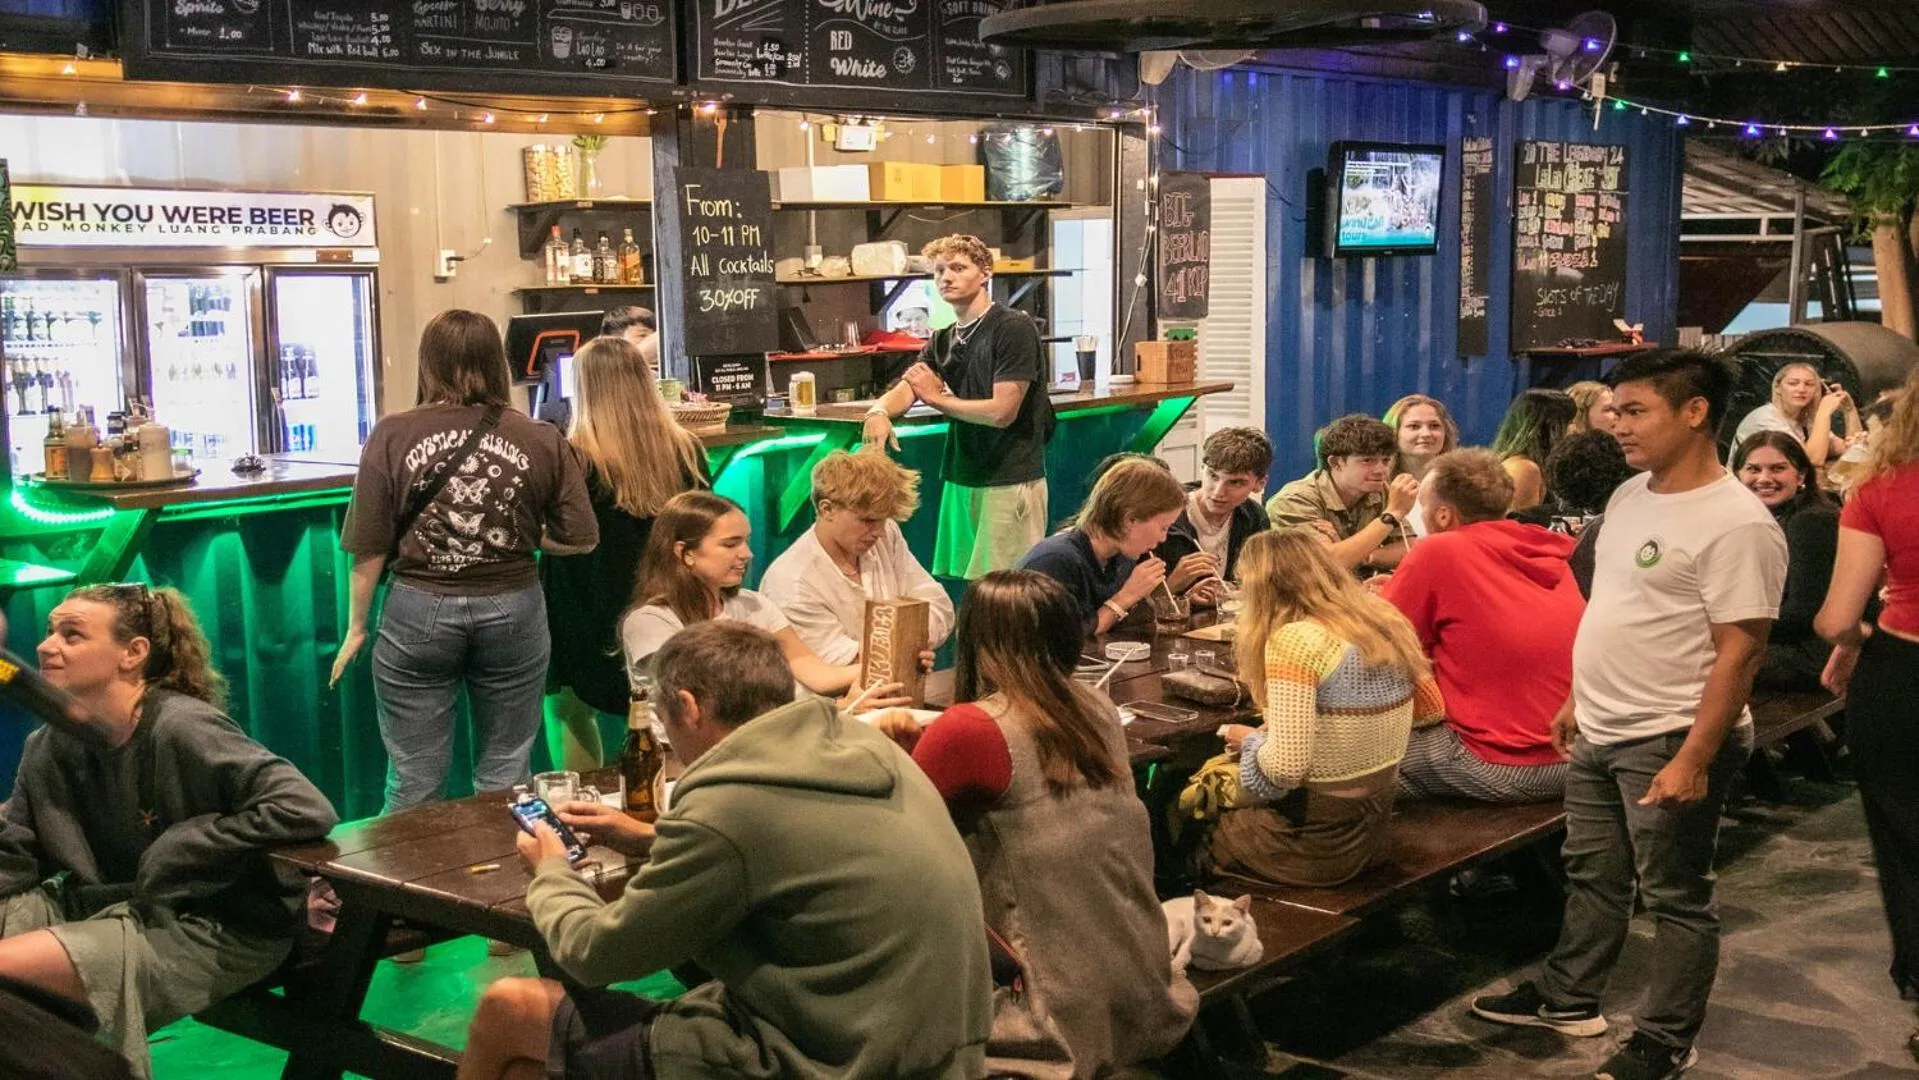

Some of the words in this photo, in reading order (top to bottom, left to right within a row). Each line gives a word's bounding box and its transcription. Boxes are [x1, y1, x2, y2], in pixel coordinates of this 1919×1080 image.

[413, 14, 457, 29] MARTINI
[475, 14, 510, 31] MOJITO
[308, 42, 324, 54] Mix
[326, 45, 343, 55] with
[347, 44, 361, 55] Red
[829, 30, 853, 51] RED
[446, 49, 457, 57] IN
[461, 49, 481, 60] THE
[485, 46, 520, 61] JUNGLE
[830, 56, 887, 79] White
[1536, 142, 1560, 163] THE
[685, 184, 743, 218] From:
[1163, 192, 1195, 228] BIG
[11, 201, 85, 222] WISH
[94, 203, 154, 223] YOU
[161, 205, 243, 225] WERE
[250, 207, 315, 227] BEER
[63, 222, 147, 234] MONKEY
[158, 224, 222, 235] LUANG
[231, 226, 318, 236] PRABANG
[692, 225, 734, 247] 10-11
[741, 224, 761, 247] PM
[691, 253, 710, 276] All
[719, 250, 774, 274] Cocktails
[1598, 282, 1620, 312] DAY
[711, 375, 736, 384] CLOSED
[736, 374, 754, 382] FROM
[722, 383, 732, 391] PM
